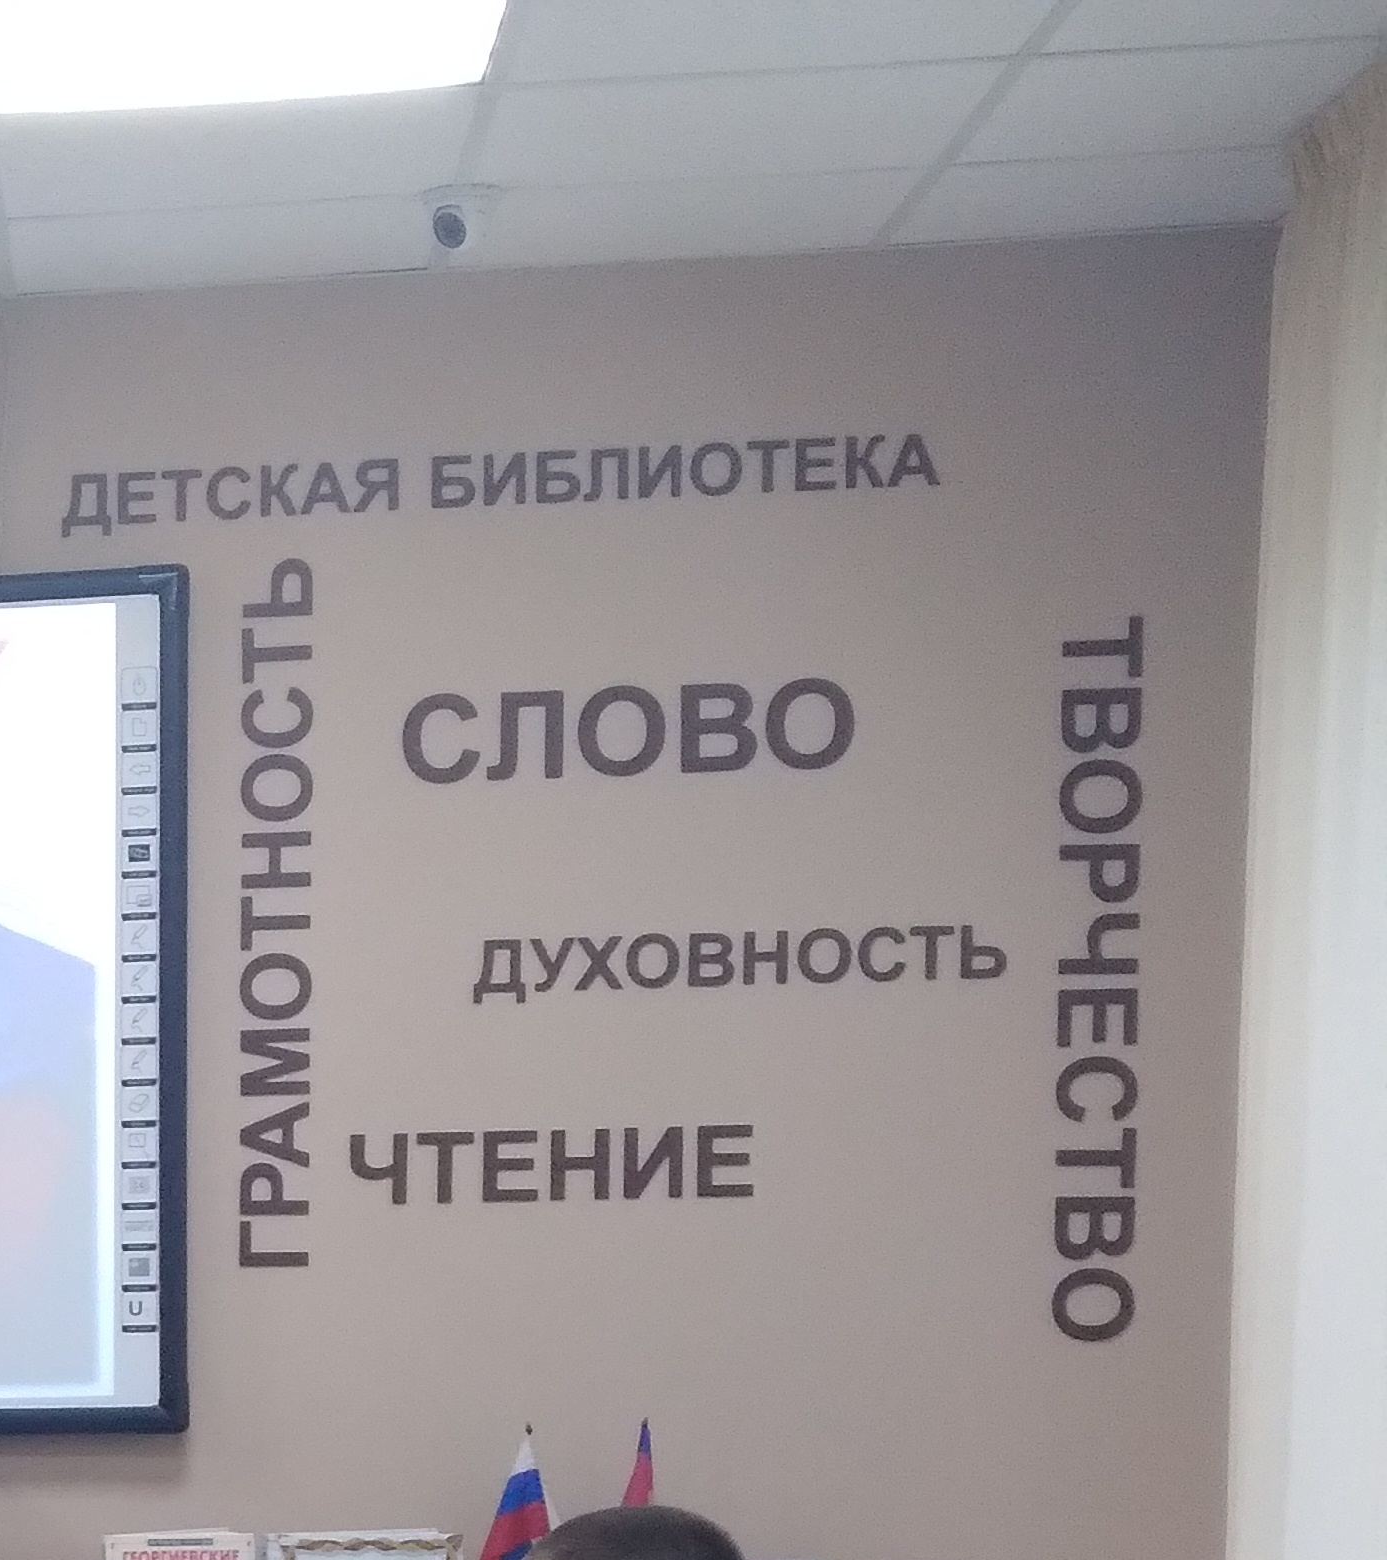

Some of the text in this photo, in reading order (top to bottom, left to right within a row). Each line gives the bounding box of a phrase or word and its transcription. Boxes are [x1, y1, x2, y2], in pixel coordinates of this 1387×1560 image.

[61, 431, 942, 538] ДЕТСКАЯ БИБЛИОТЕКА
[403, 677, 856, 784] СЛОВО
[238, 558, 313, 1268] ГРАМОТНОСТЬ
[473, 924, 1008, 1004] ДУХОВНОСТЬ
[1052, 615, 1144, 1343] ТВОРЧЕСТВО
[350, 1125, 753, 1205] ЧТЕНИЕ
